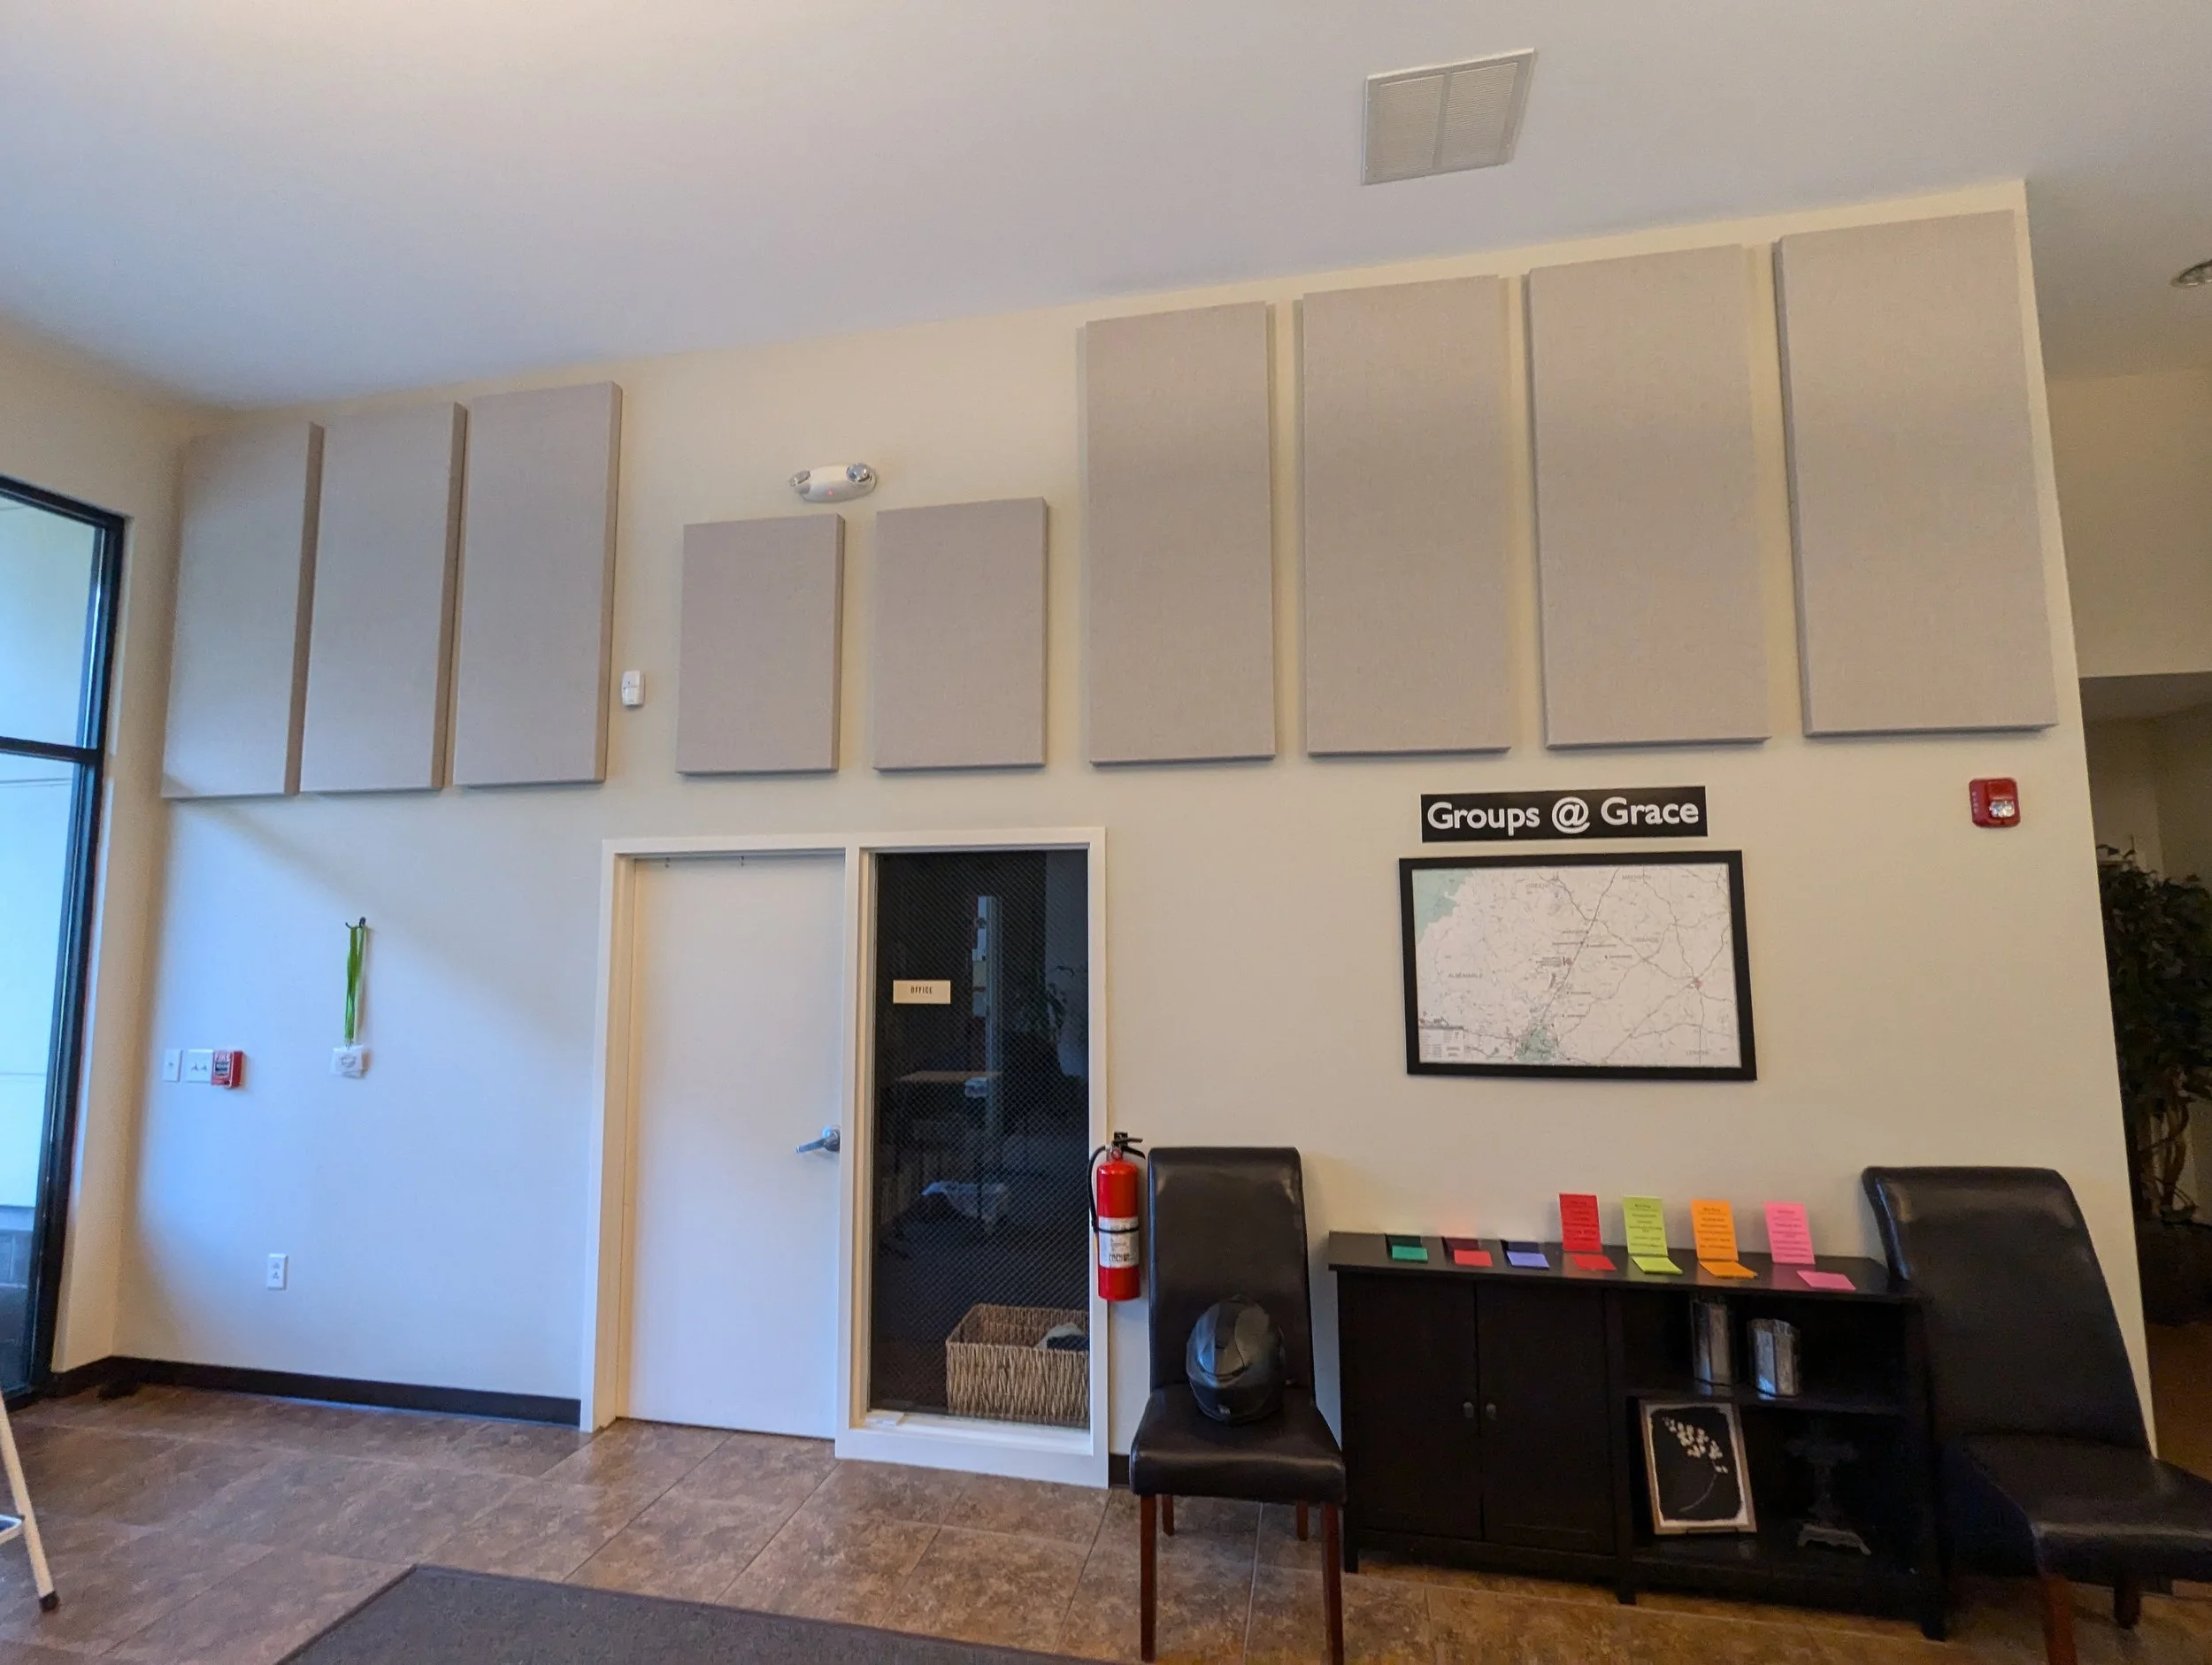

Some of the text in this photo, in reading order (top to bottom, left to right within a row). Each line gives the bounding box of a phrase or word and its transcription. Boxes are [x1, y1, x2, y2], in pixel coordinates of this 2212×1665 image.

[1426, 796, 1699, 836] Groups @ Grace
[910, 986, 933, 994] OFFICE
